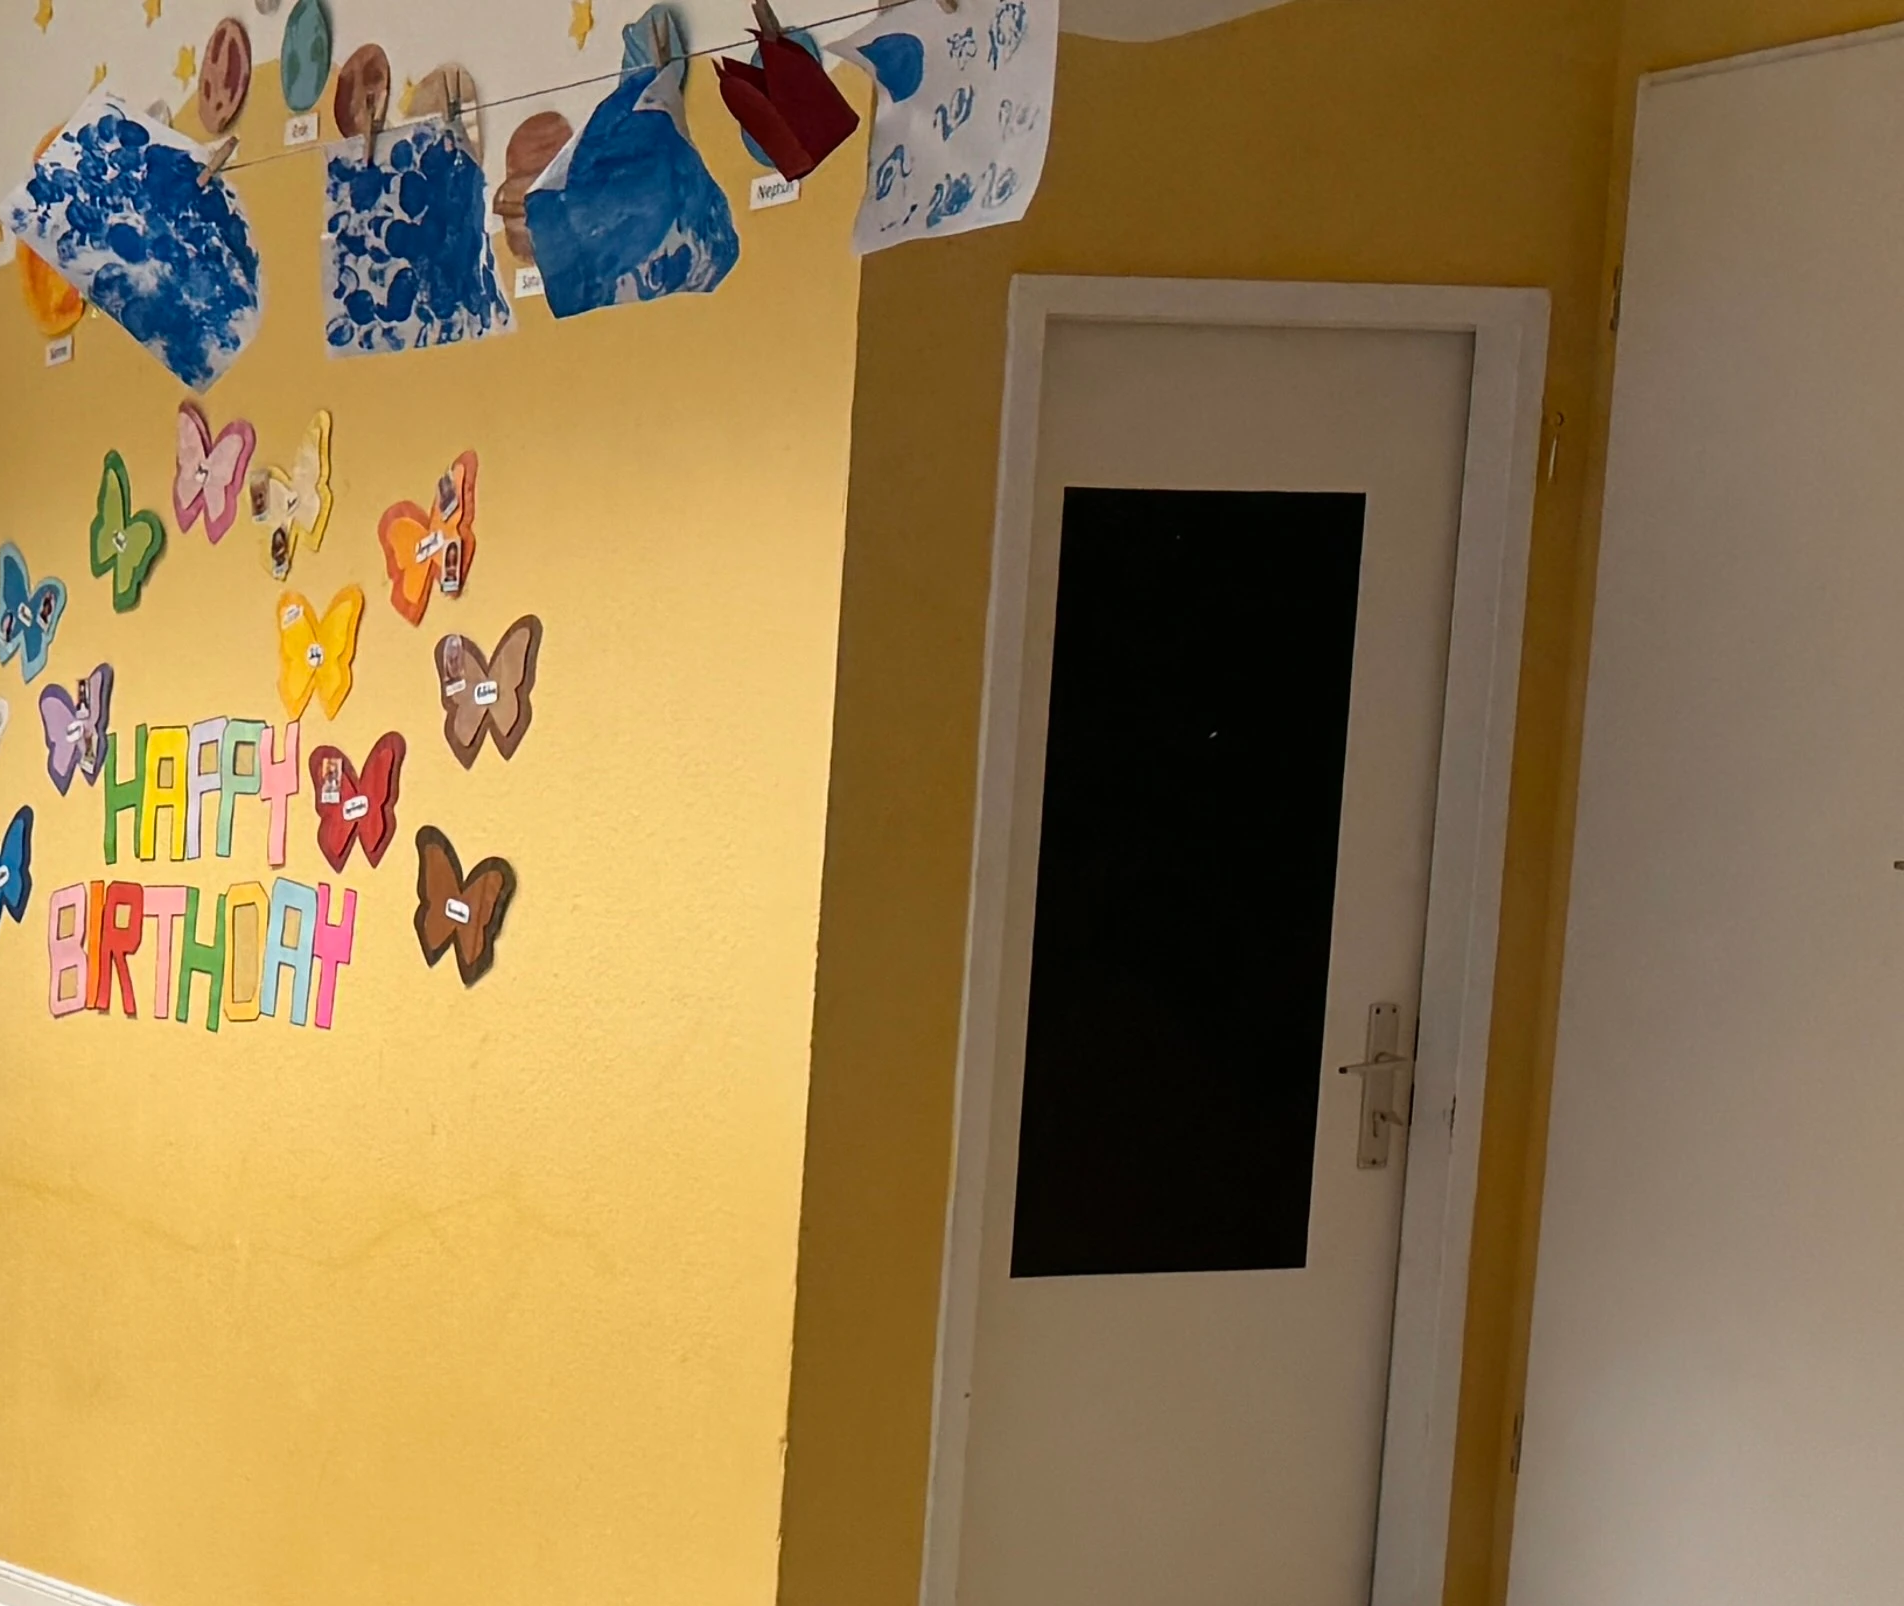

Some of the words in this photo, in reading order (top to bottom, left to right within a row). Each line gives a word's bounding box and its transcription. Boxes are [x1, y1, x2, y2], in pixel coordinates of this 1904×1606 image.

[756, 181, 795, 200] Neptun
[104, 716, 299, 870] HAPPY
[49, 877, 358, 1032] BIRTHDAY
